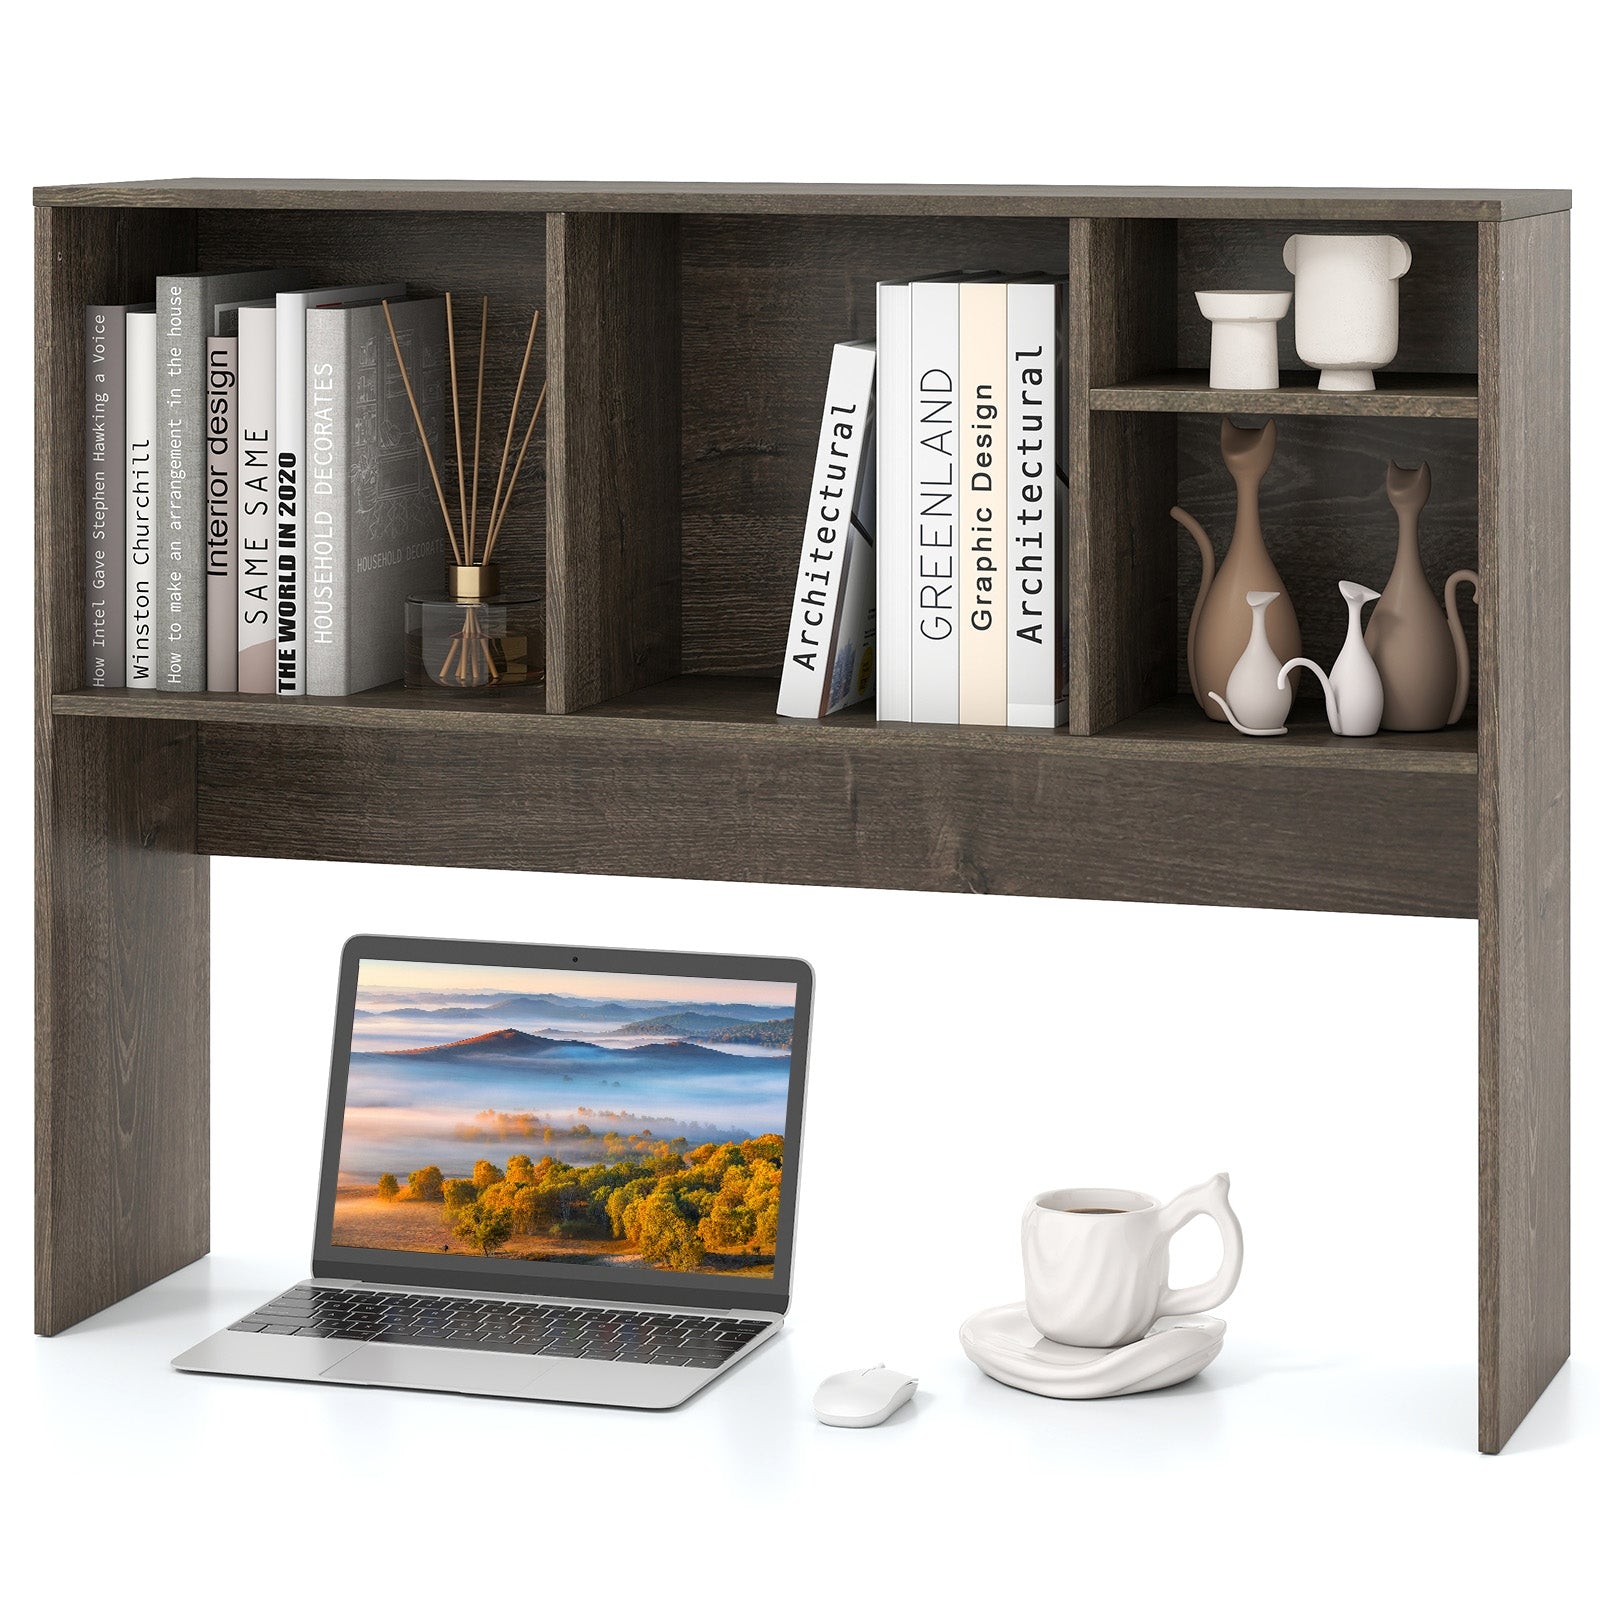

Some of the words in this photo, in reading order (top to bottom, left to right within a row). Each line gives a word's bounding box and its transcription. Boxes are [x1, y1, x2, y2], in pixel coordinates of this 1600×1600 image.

[92, 315, 105, 363] Voice
[167, 287, 181, 336] house
[95, 375, 105, 383] a
[167, 347, 181, 376] the
[92, 393, 109, 461] Hawking
[167, 388, 181, 407] in
[207, 350, 235, 455] design
[313, 362, 333, 495] DECORATES
[971, 384, 998, 491] Design
[93, 472, 108, 540] Stephen
[133, 439, 149, 564] Churchill
[169, 419, 186, 530] arrangement
[245, 429, 268, 515] SAME
[278, 453, 296, 516] 2020
[920, 368, 953, 641] GREENLAND
[1015, 345, 1043, 645] Architectural
[170, 541, 181, 560] an
[207, 465, 228, 576] Interior
[279, 524, 296, 548] IN
[792, 404, 856, 672] Architectural
[93, 550, 105, 589] Gave
[167, 572, 181, 612] make
[245, 538, 268, 624] SAME
[313, 510, 333, 644] HOUSEHOLD
[356, 549, 401, 573] HOUSEHOLD
[971, 506, 998, 631] Graphic
[93, 600, 105, 647] Intel
[133, 581, 149, 679] Winston
[169, 623, 181, 641] to
[278, 555, 296, 642] WORLD
[93, 657, 105, 687] How
[168, 653, 181, 683] How
[278, 649, 296, 693] THE
